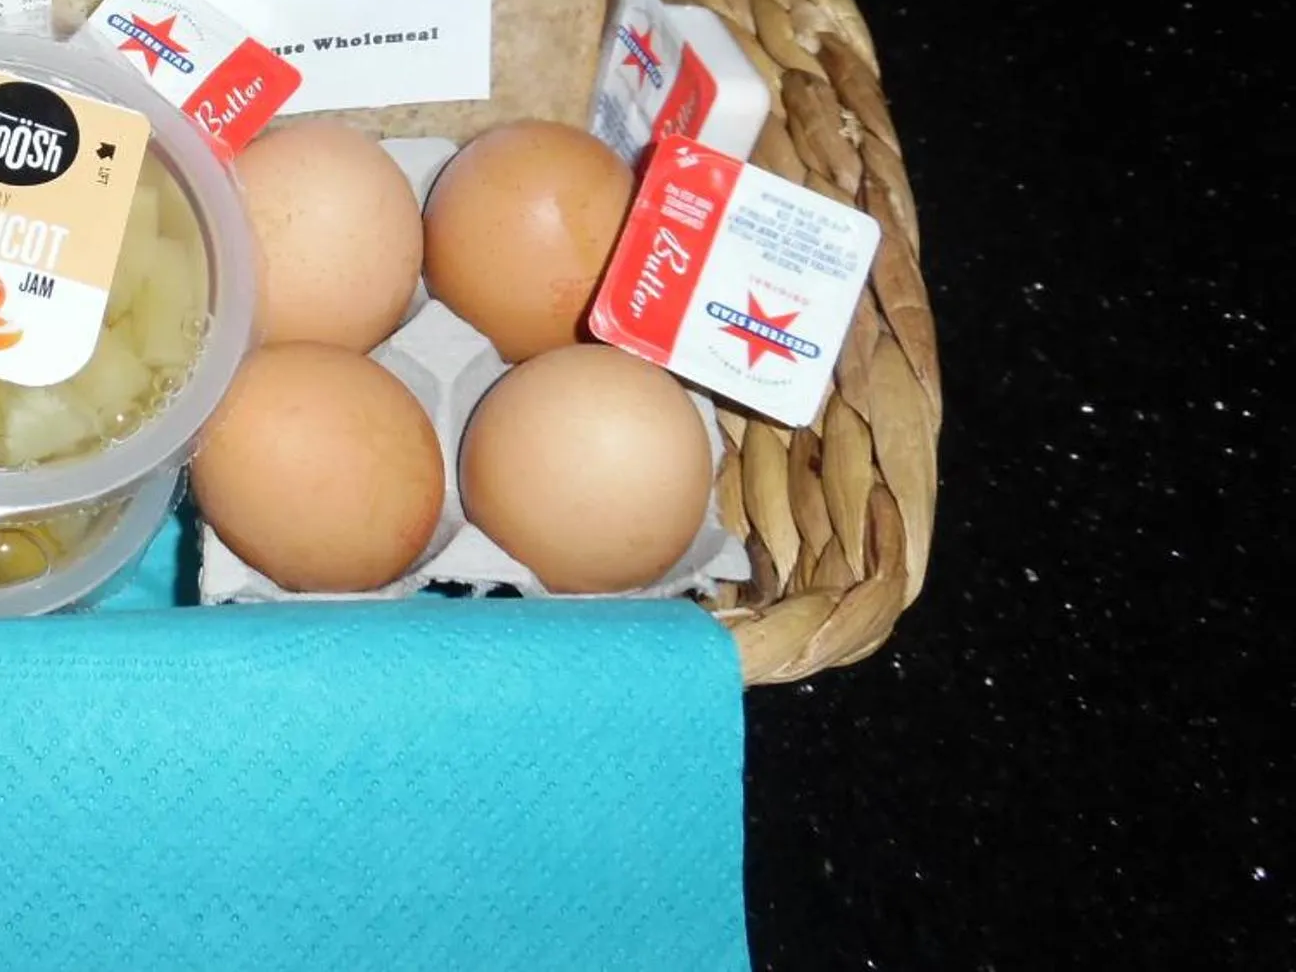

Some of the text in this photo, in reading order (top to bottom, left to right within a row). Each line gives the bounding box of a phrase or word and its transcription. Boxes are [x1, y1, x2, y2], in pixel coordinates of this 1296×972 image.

[110, 14, 162, 54] WESTERN
[160, 45, 193, 73] STAR
[313, 27, 439, 51] Wholemeal
[194, 75, 265, 140] Butter
[18, 271, 55, 300] JAM
[628, 225, 691, 320] Butter
[708, 302, 819, 359] WESTERN STAR
